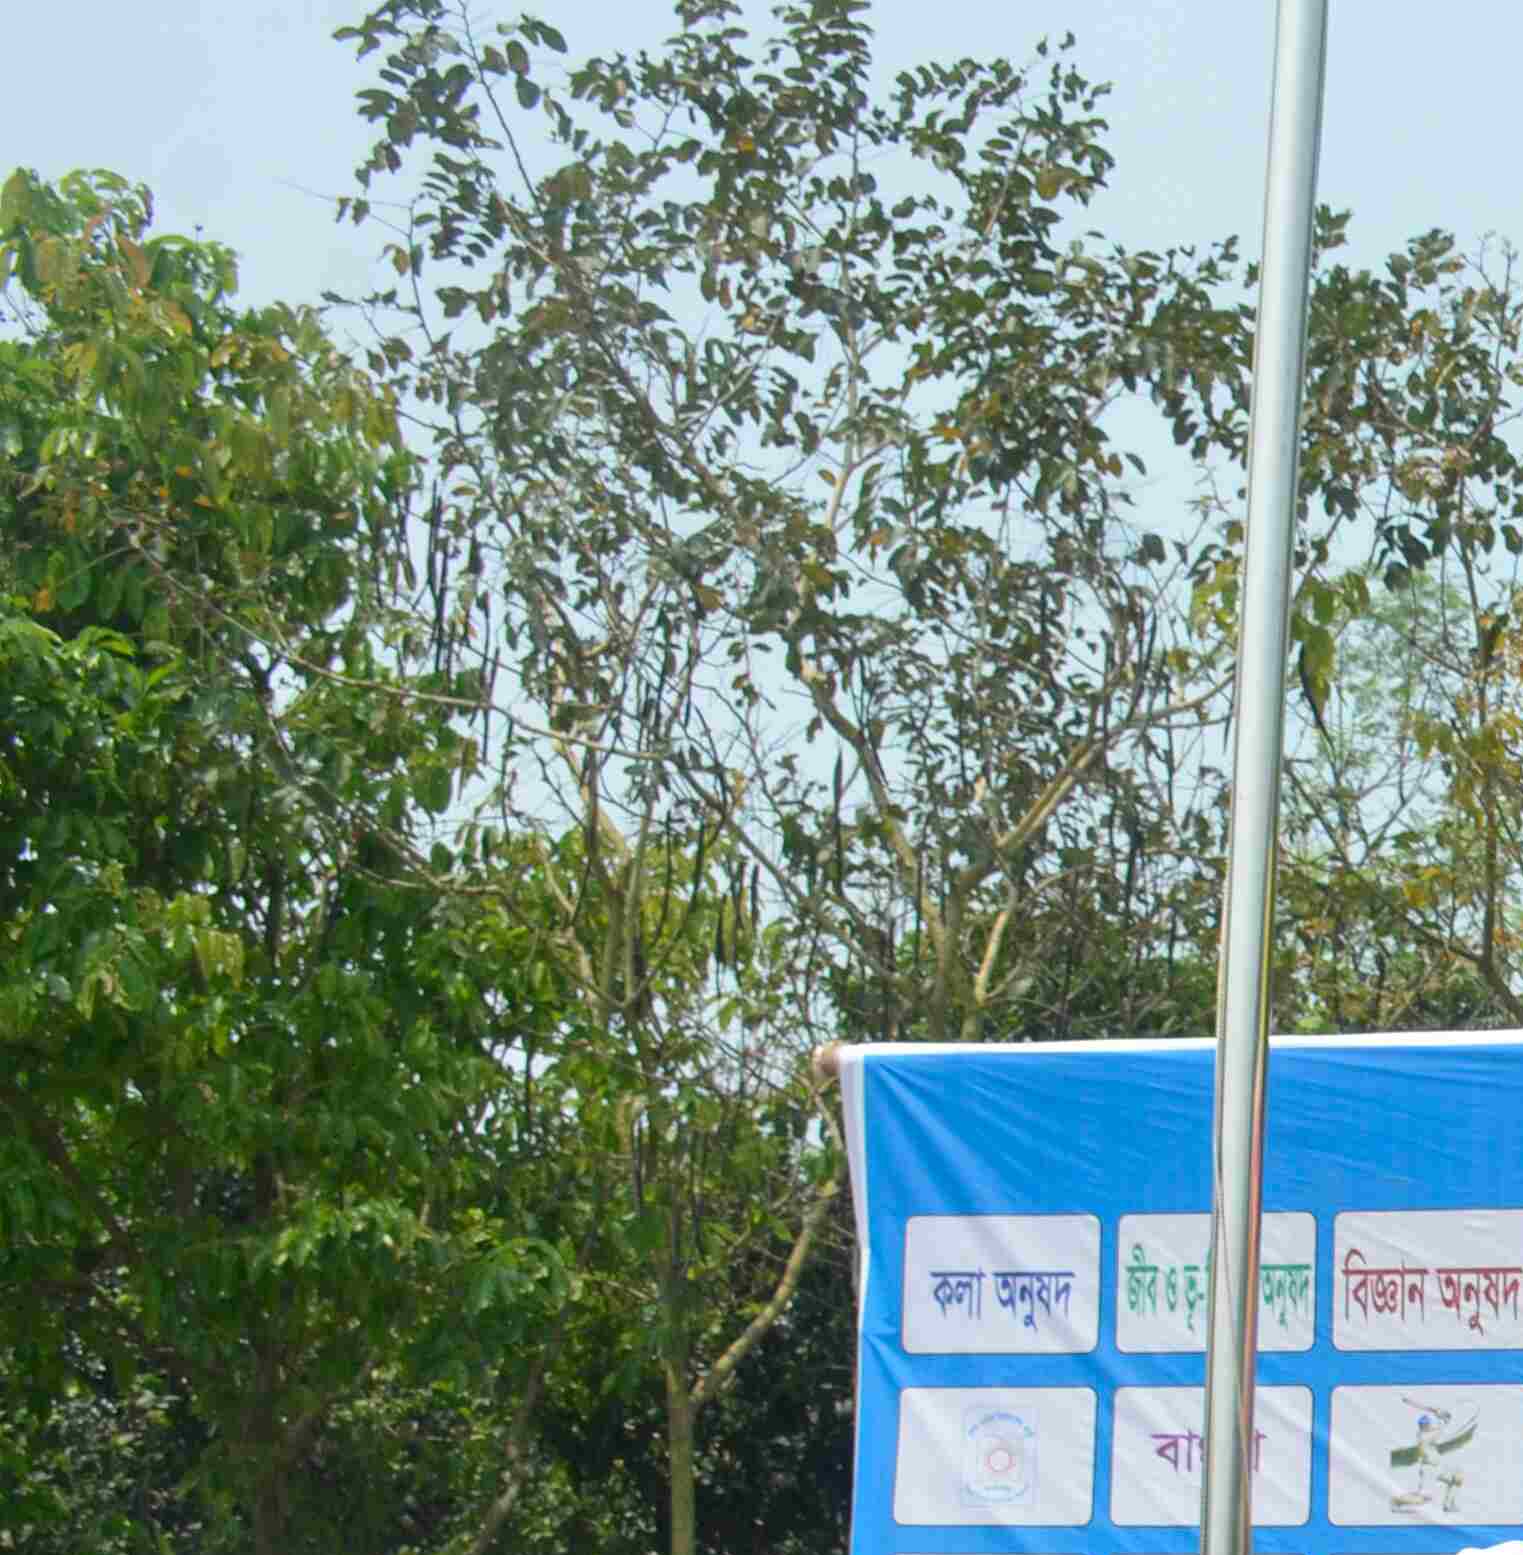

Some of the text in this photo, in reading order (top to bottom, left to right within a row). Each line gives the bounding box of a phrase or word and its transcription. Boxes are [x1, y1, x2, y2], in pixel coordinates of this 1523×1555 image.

[929, 1266, 1075, 1332] কলা অনুষদ
[1125, 1243, 1158, 1318] জীব
[1165, 1266, 1177, 1312] ও
[1341, 1247, 1523, 1336] বিজ্ঞান অনুষদ
